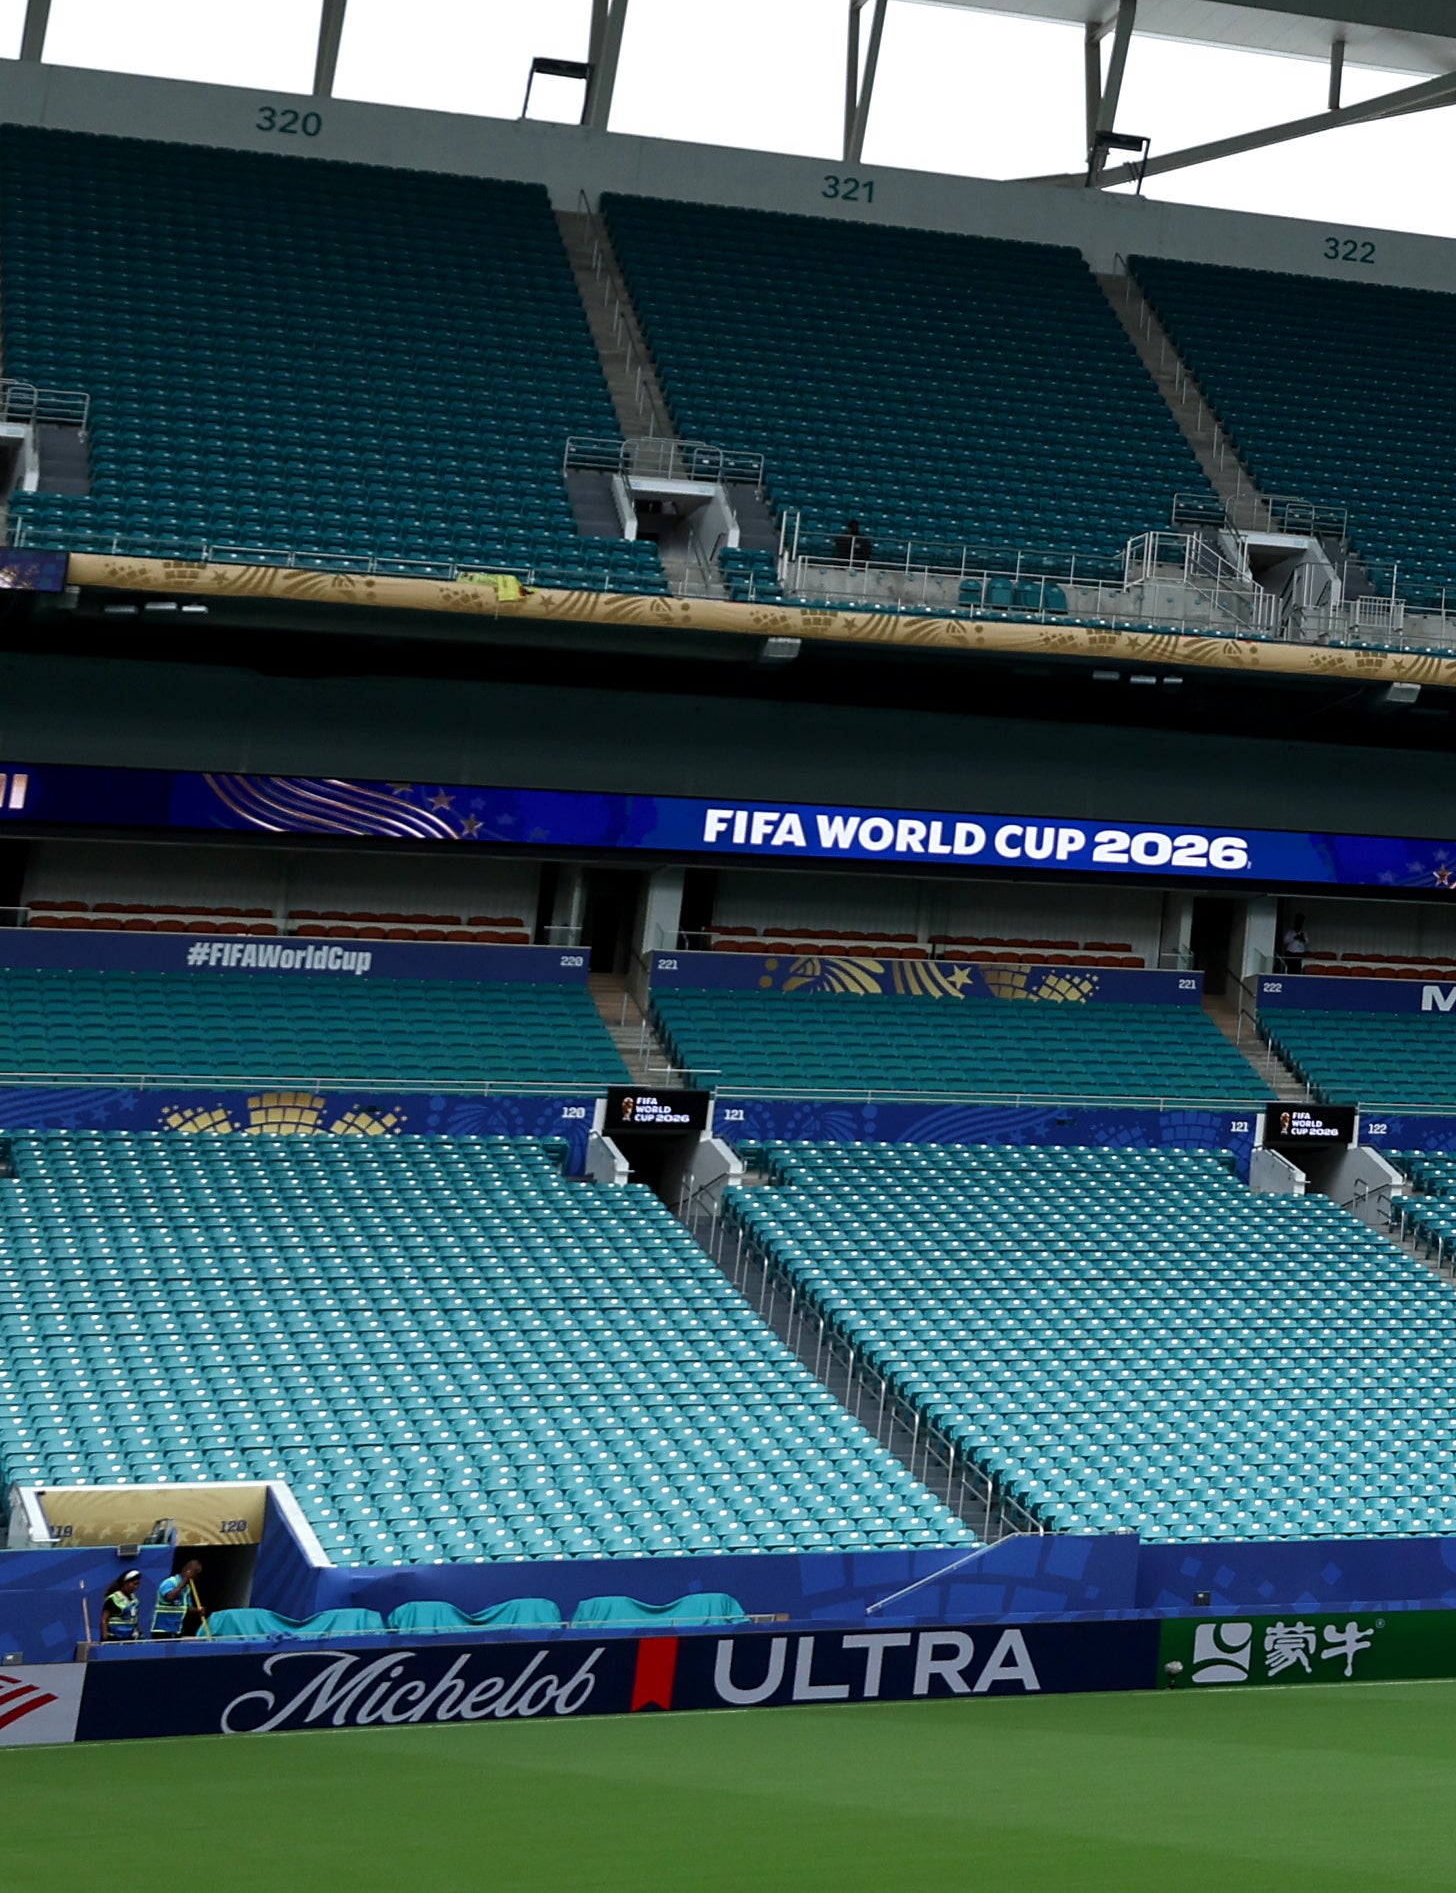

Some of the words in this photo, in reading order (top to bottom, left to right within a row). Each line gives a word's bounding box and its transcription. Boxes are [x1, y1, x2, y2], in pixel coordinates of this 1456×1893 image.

[256, 106, 322, 137] 320
[821, 175, 875, 203] 321
[1324, 237, 1376, 264] 322
[703, 808, 806, 847] FIFA
[816, 814, 986, 856] WORLD
[994, 824, 1086, 861] CUP
[1092, 829, 1248, 871] 2026
[187, 941, 372, 975] #FIFAWorldCup
[560, 955, 584, 967] 220
[658, 959, 679, 970] 221
[1178, 978, 1197, 990] 221
[1263, 982, 1282, 993] 222
[636, 1096, 658, 1106] FIFA
[562, 1106, 586, 1119] 120
[635, 1105, 672, 1114] WORLD
[724, 1109, 745, 1121] 121
[1291, 1111, 1311, 1120] FIFA
[634, 1114, 655, 1122] CUP
[655, 1113, 690, 1123] 2026
[1291, 1120, 1323, 1128] WORLD
[1230, 1121, 1249, 1133] 121
[1291, 1128, 1308, 1136] CUP
[1368, 1123, 1388, 1135] 122
[220, 1520, 247, 1533] 120
[1264, 1621, 1375, 1677] 蒙牛
[221, 1647, 606, 1734] Michelob
[714, 1629, 1041, 1705] ULTRA
